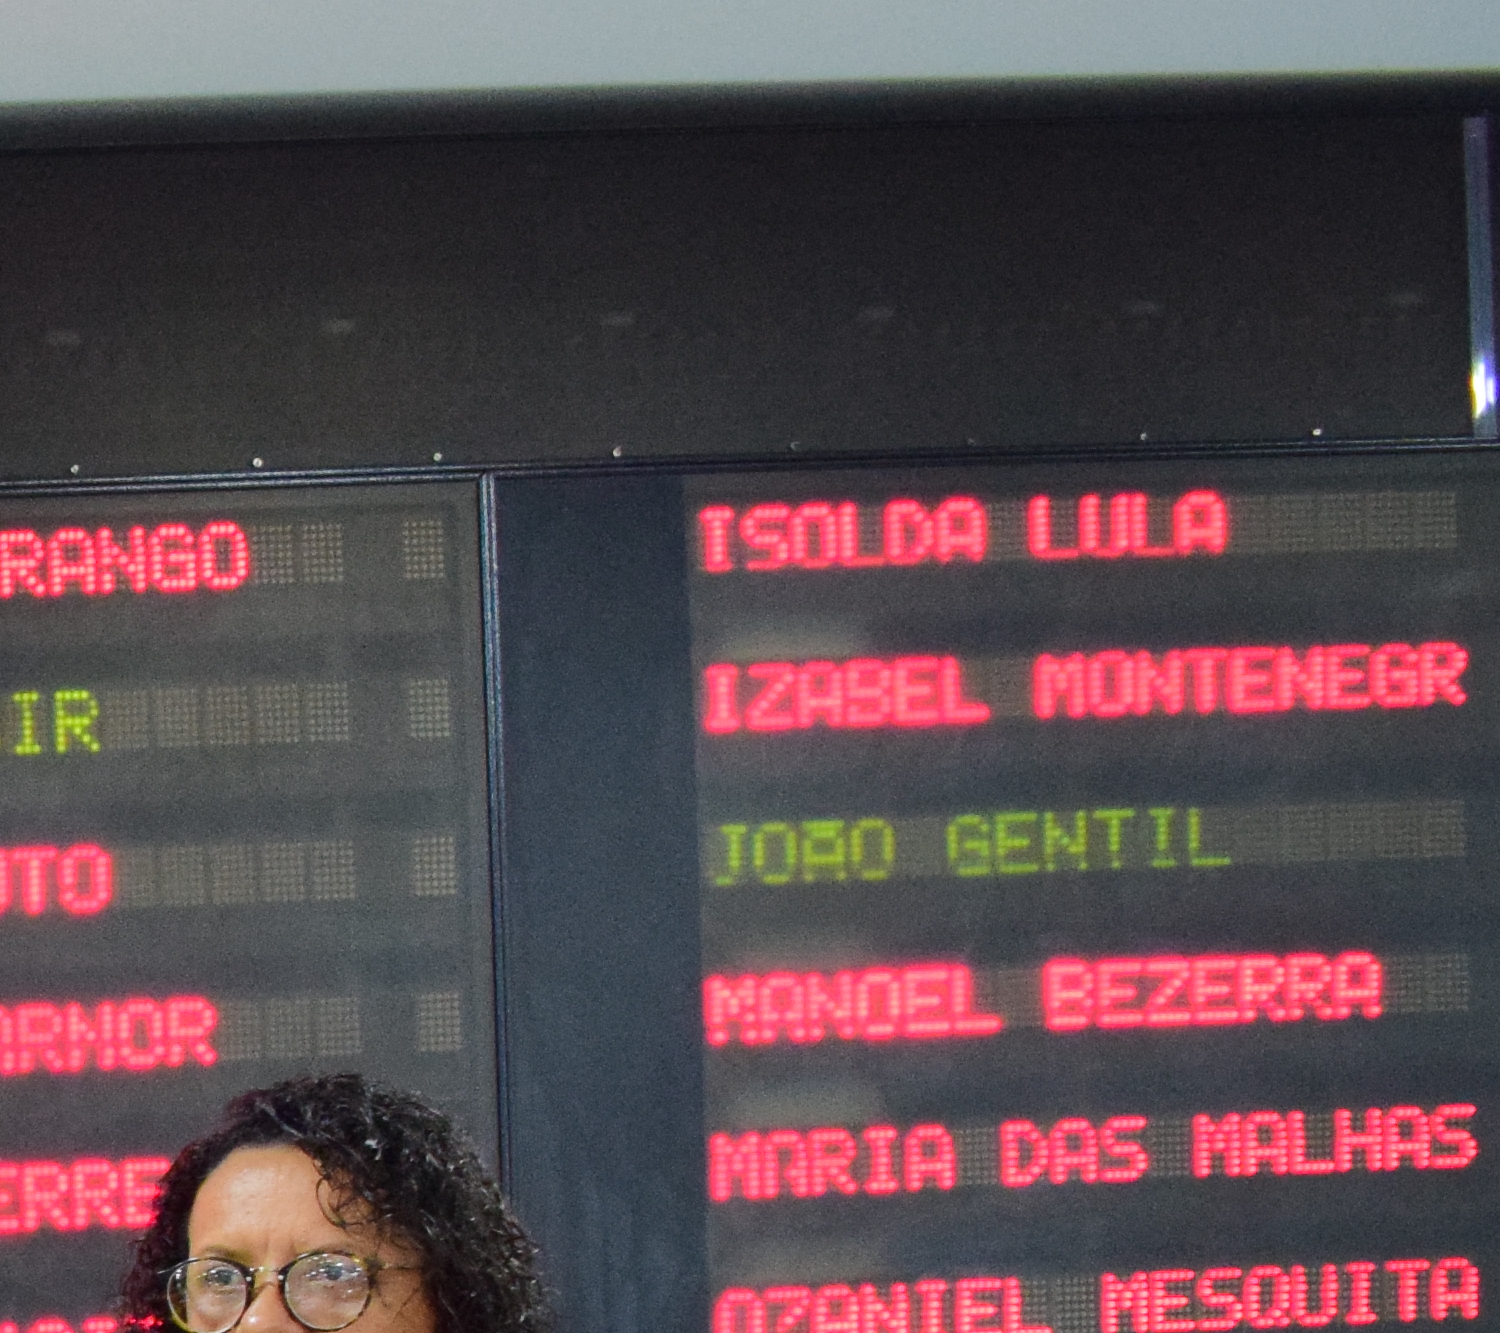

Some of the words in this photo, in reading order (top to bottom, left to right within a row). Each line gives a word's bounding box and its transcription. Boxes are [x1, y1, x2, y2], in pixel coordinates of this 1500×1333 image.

[699, 496, 989, 572] ISOLDA
[1027, 490, 1229, 560] LULA
[703, 655, 991, 735] IZABEL
[1032, 642, 1468, 719] MONTENEGR
[946, 808, 1229, 876] GENTIL
[703, 961, 1004, 1047] MANOEL
[1040, 951, 1383, 1032] BEZERRA
[709, 1124, 957, 1202] MARIA
[999, 1116, 1150, 1187] DAS
[1192, 1104, 1478, 1178] MALHAS
